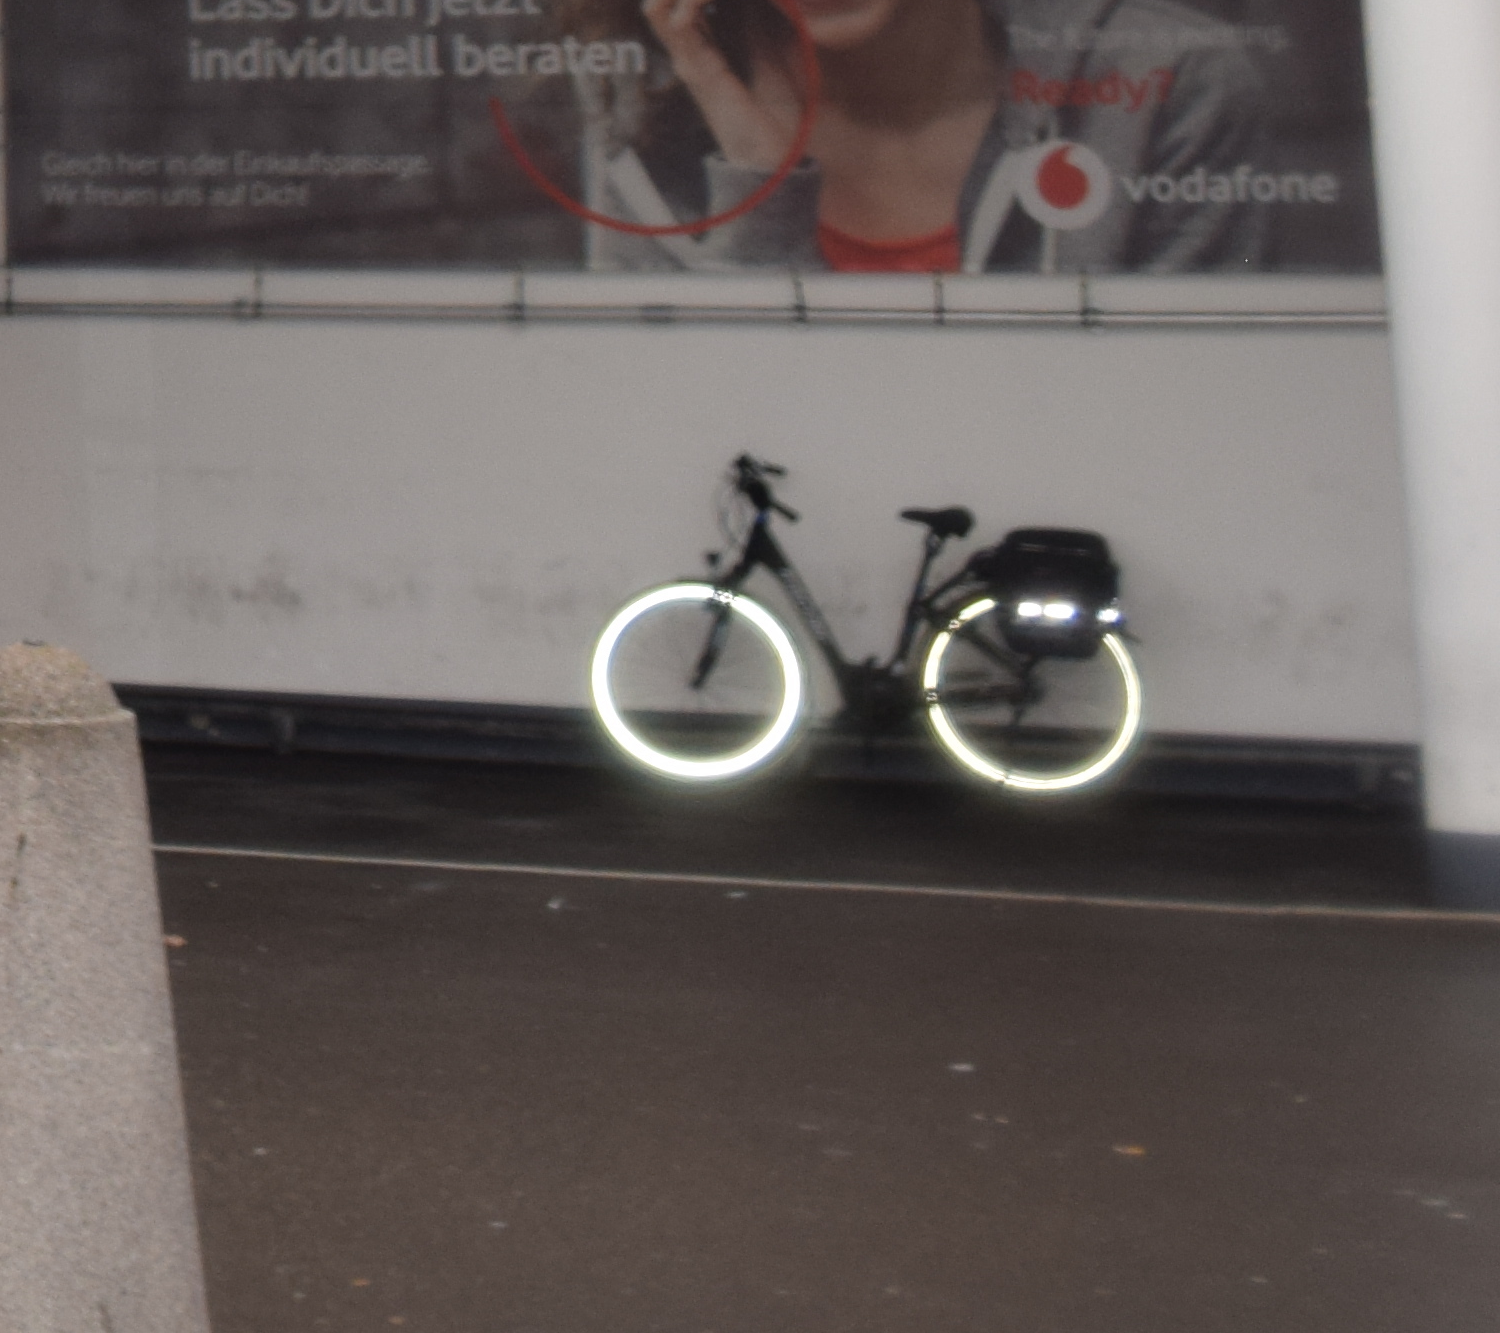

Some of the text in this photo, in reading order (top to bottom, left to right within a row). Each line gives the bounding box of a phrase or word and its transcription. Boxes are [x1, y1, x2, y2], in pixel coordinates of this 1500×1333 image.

[188, 35, 647, 81] individuell beraten
[1011, 66, 1174, 112] Ready?
[1122, 162, 1340, 205] vodafone
